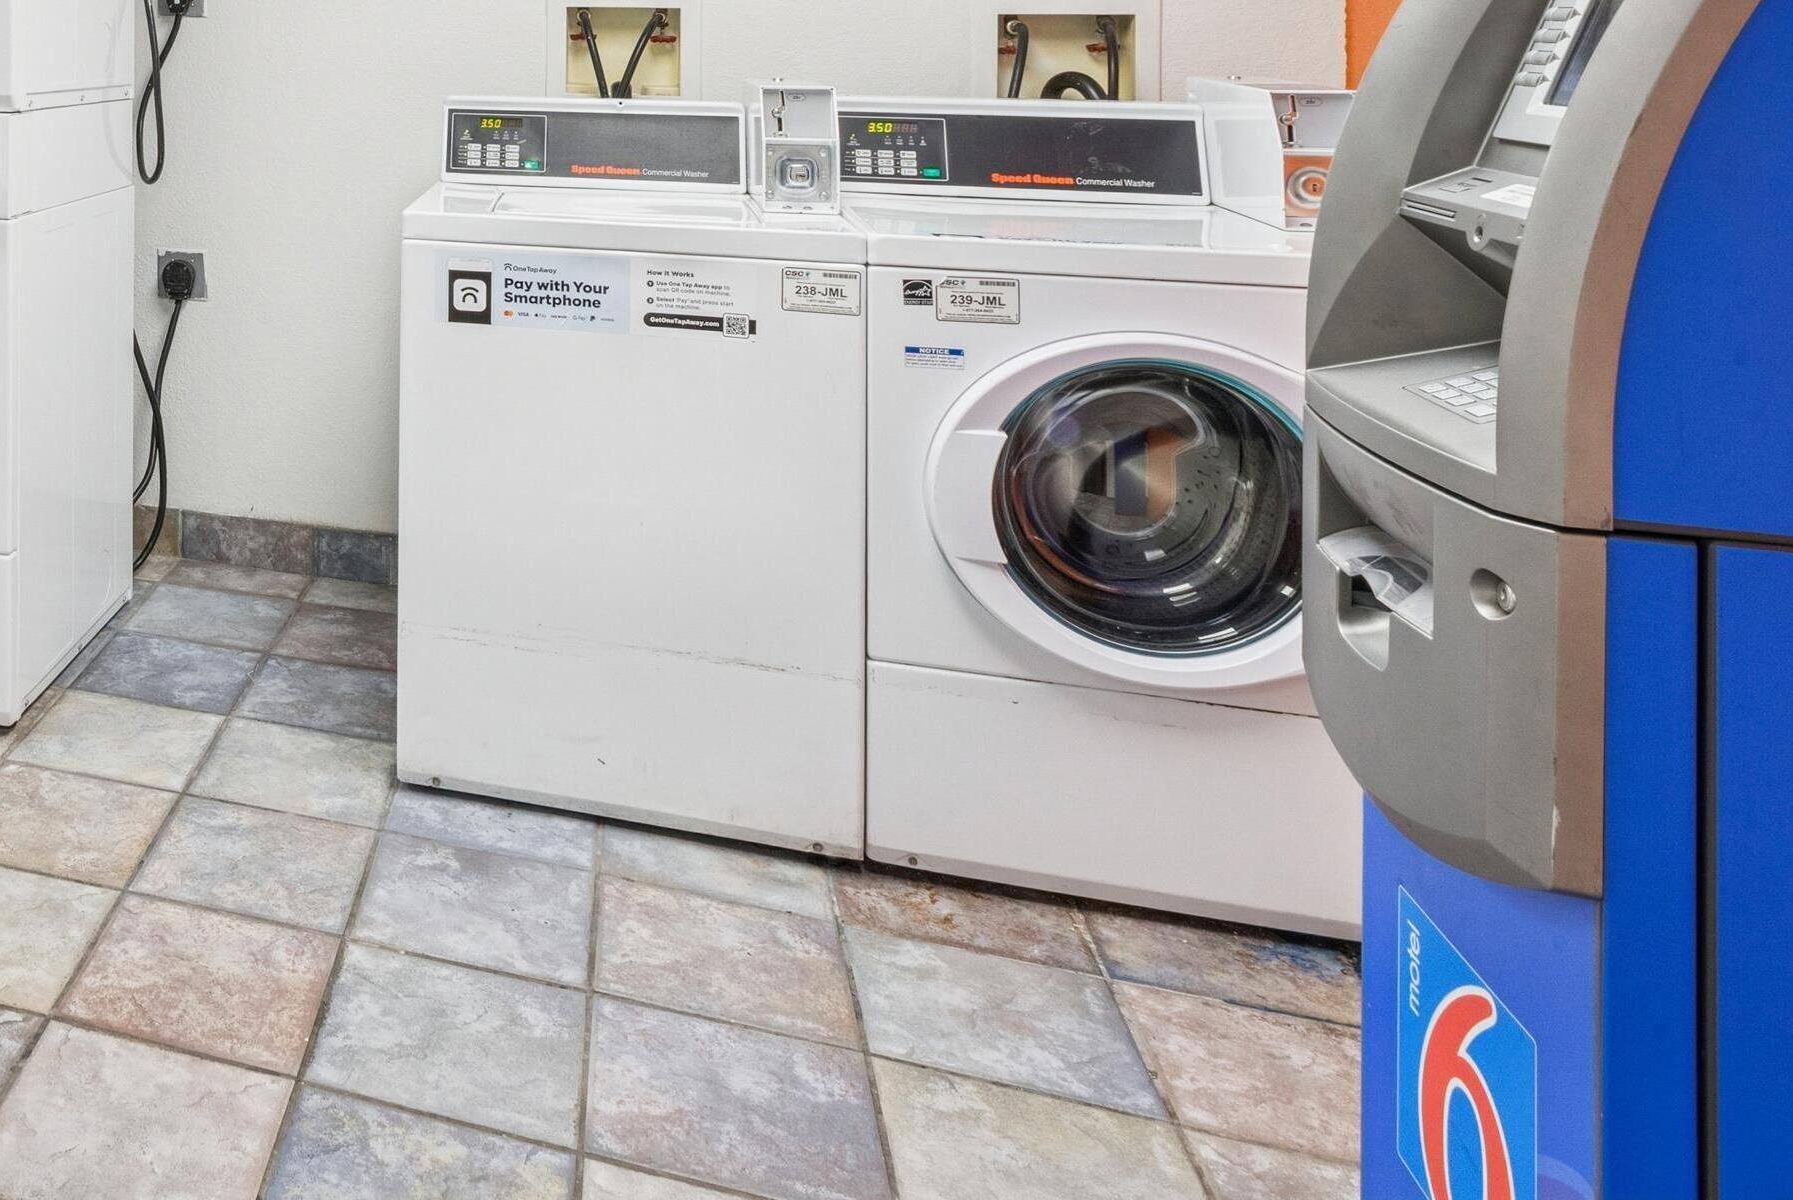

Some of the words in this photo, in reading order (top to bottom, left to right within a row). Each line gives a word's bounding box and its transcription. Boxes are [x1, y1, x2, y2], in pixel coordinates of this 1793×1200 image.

[571, 165, 605, 175] Speed
[607, 166, 640, 176] Queen
[642, 168, 682, 177] Commercial
[683, 170, 709, 178] Washer
[991, 173, 1032, 184] Speed
[1033, 174, 1074, 186] Queen
[1076, 176, 1123, 187] Commercial
[1124, 178, 1155, 188] Washer
[671, 270, 694, 278] Works
[504, 278, 533, 292] Pay
[537, 279, 570, 292] with
[573, 281, 609, 294] Your
[795, 285, 848, 298] 238-JML
[504, 292, 601, 308] Smartphone
[950, 294, 1006, 307] 239-JML
[650, 316, 720, 328] GetOneTapAway.com
[919, 347, 950, 355] NOTICE
[1407, 921, 1421, 1016] motel
[1417, 984, 1515, 1200] 6
